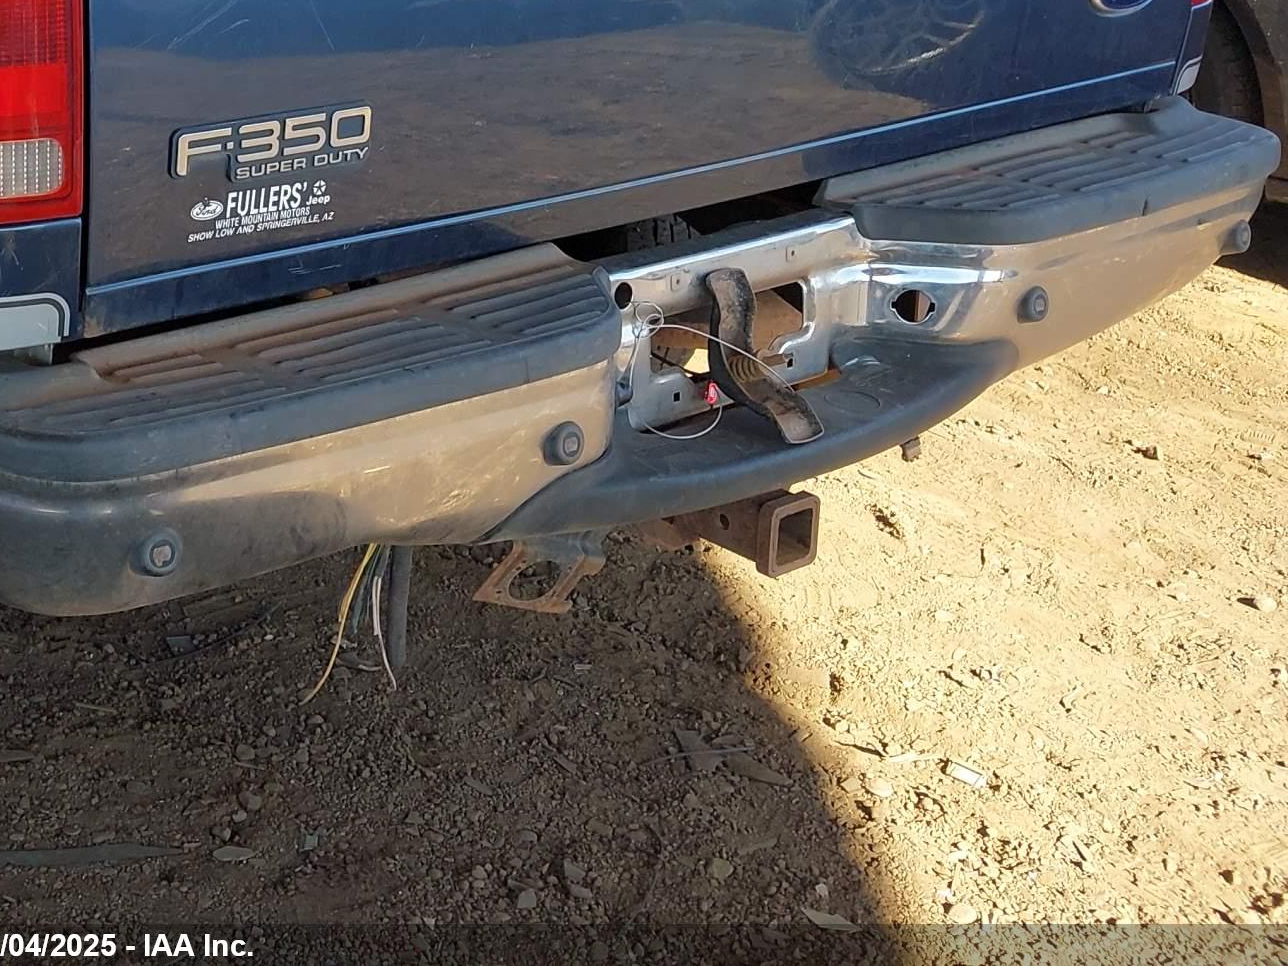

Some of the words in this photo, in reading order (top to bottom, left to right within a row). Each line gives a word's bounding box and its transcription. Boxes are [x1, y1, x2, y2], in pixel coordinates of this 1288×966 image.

[176, 106, 372, 176] F-350
[235, 158, 306, 180] SUPER
[314, 147, 369, 167] DUTY
[226, 182, 308, 218] FULLERS'
[306, 194, 331, 206] Jeep
[187, 231, 215, 243] SHOW
[215, 228, 234, 238] LOW
[236, 224, 255, 235] AND
[321, 211, 335, 222] AZ
[215, 217, 240, 230] WHITE
[241, 211, 280, 225] MOUNTAIN
[281, 207, 311, 220] MOTORS
